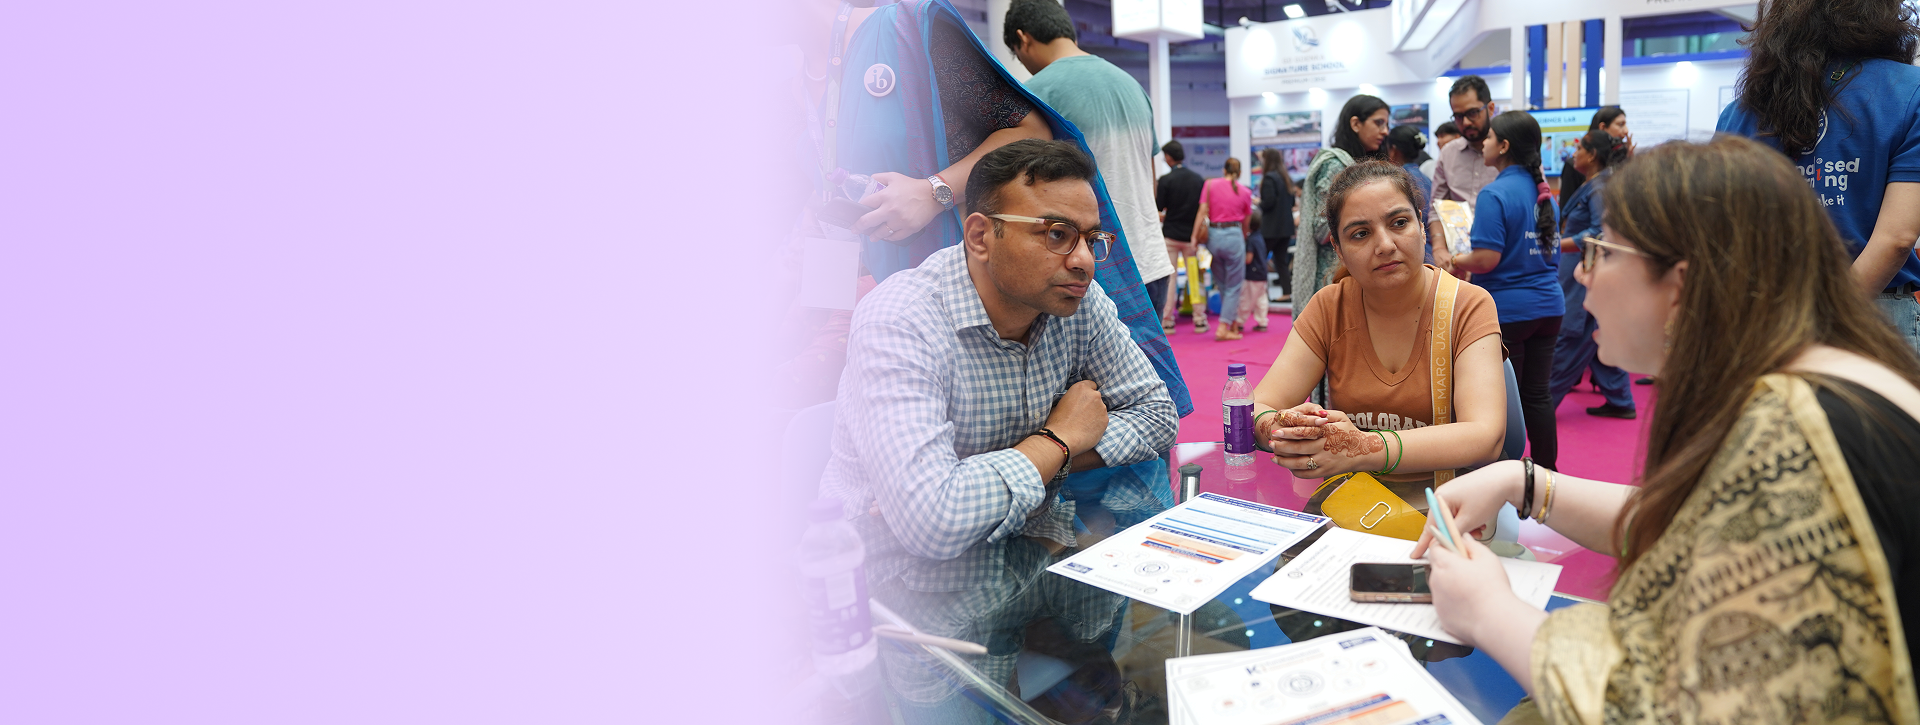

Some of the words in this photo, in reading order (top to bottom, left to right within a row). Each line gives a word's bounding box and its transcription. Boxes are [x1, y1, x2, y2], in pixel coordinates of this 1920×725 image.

[1265, 65, 1309, 75] SIGNATURE
[1312, 61, 1345, 70] SCHOOL
[1837, 194, 1845, 206] it
[1436, 290, 1451, 350] JACOBS
[1436, 356, 1447, 399] MARC
[1346, 412, 1434, 431] COLORAD
[1438, 406, 1447, 425] HE
